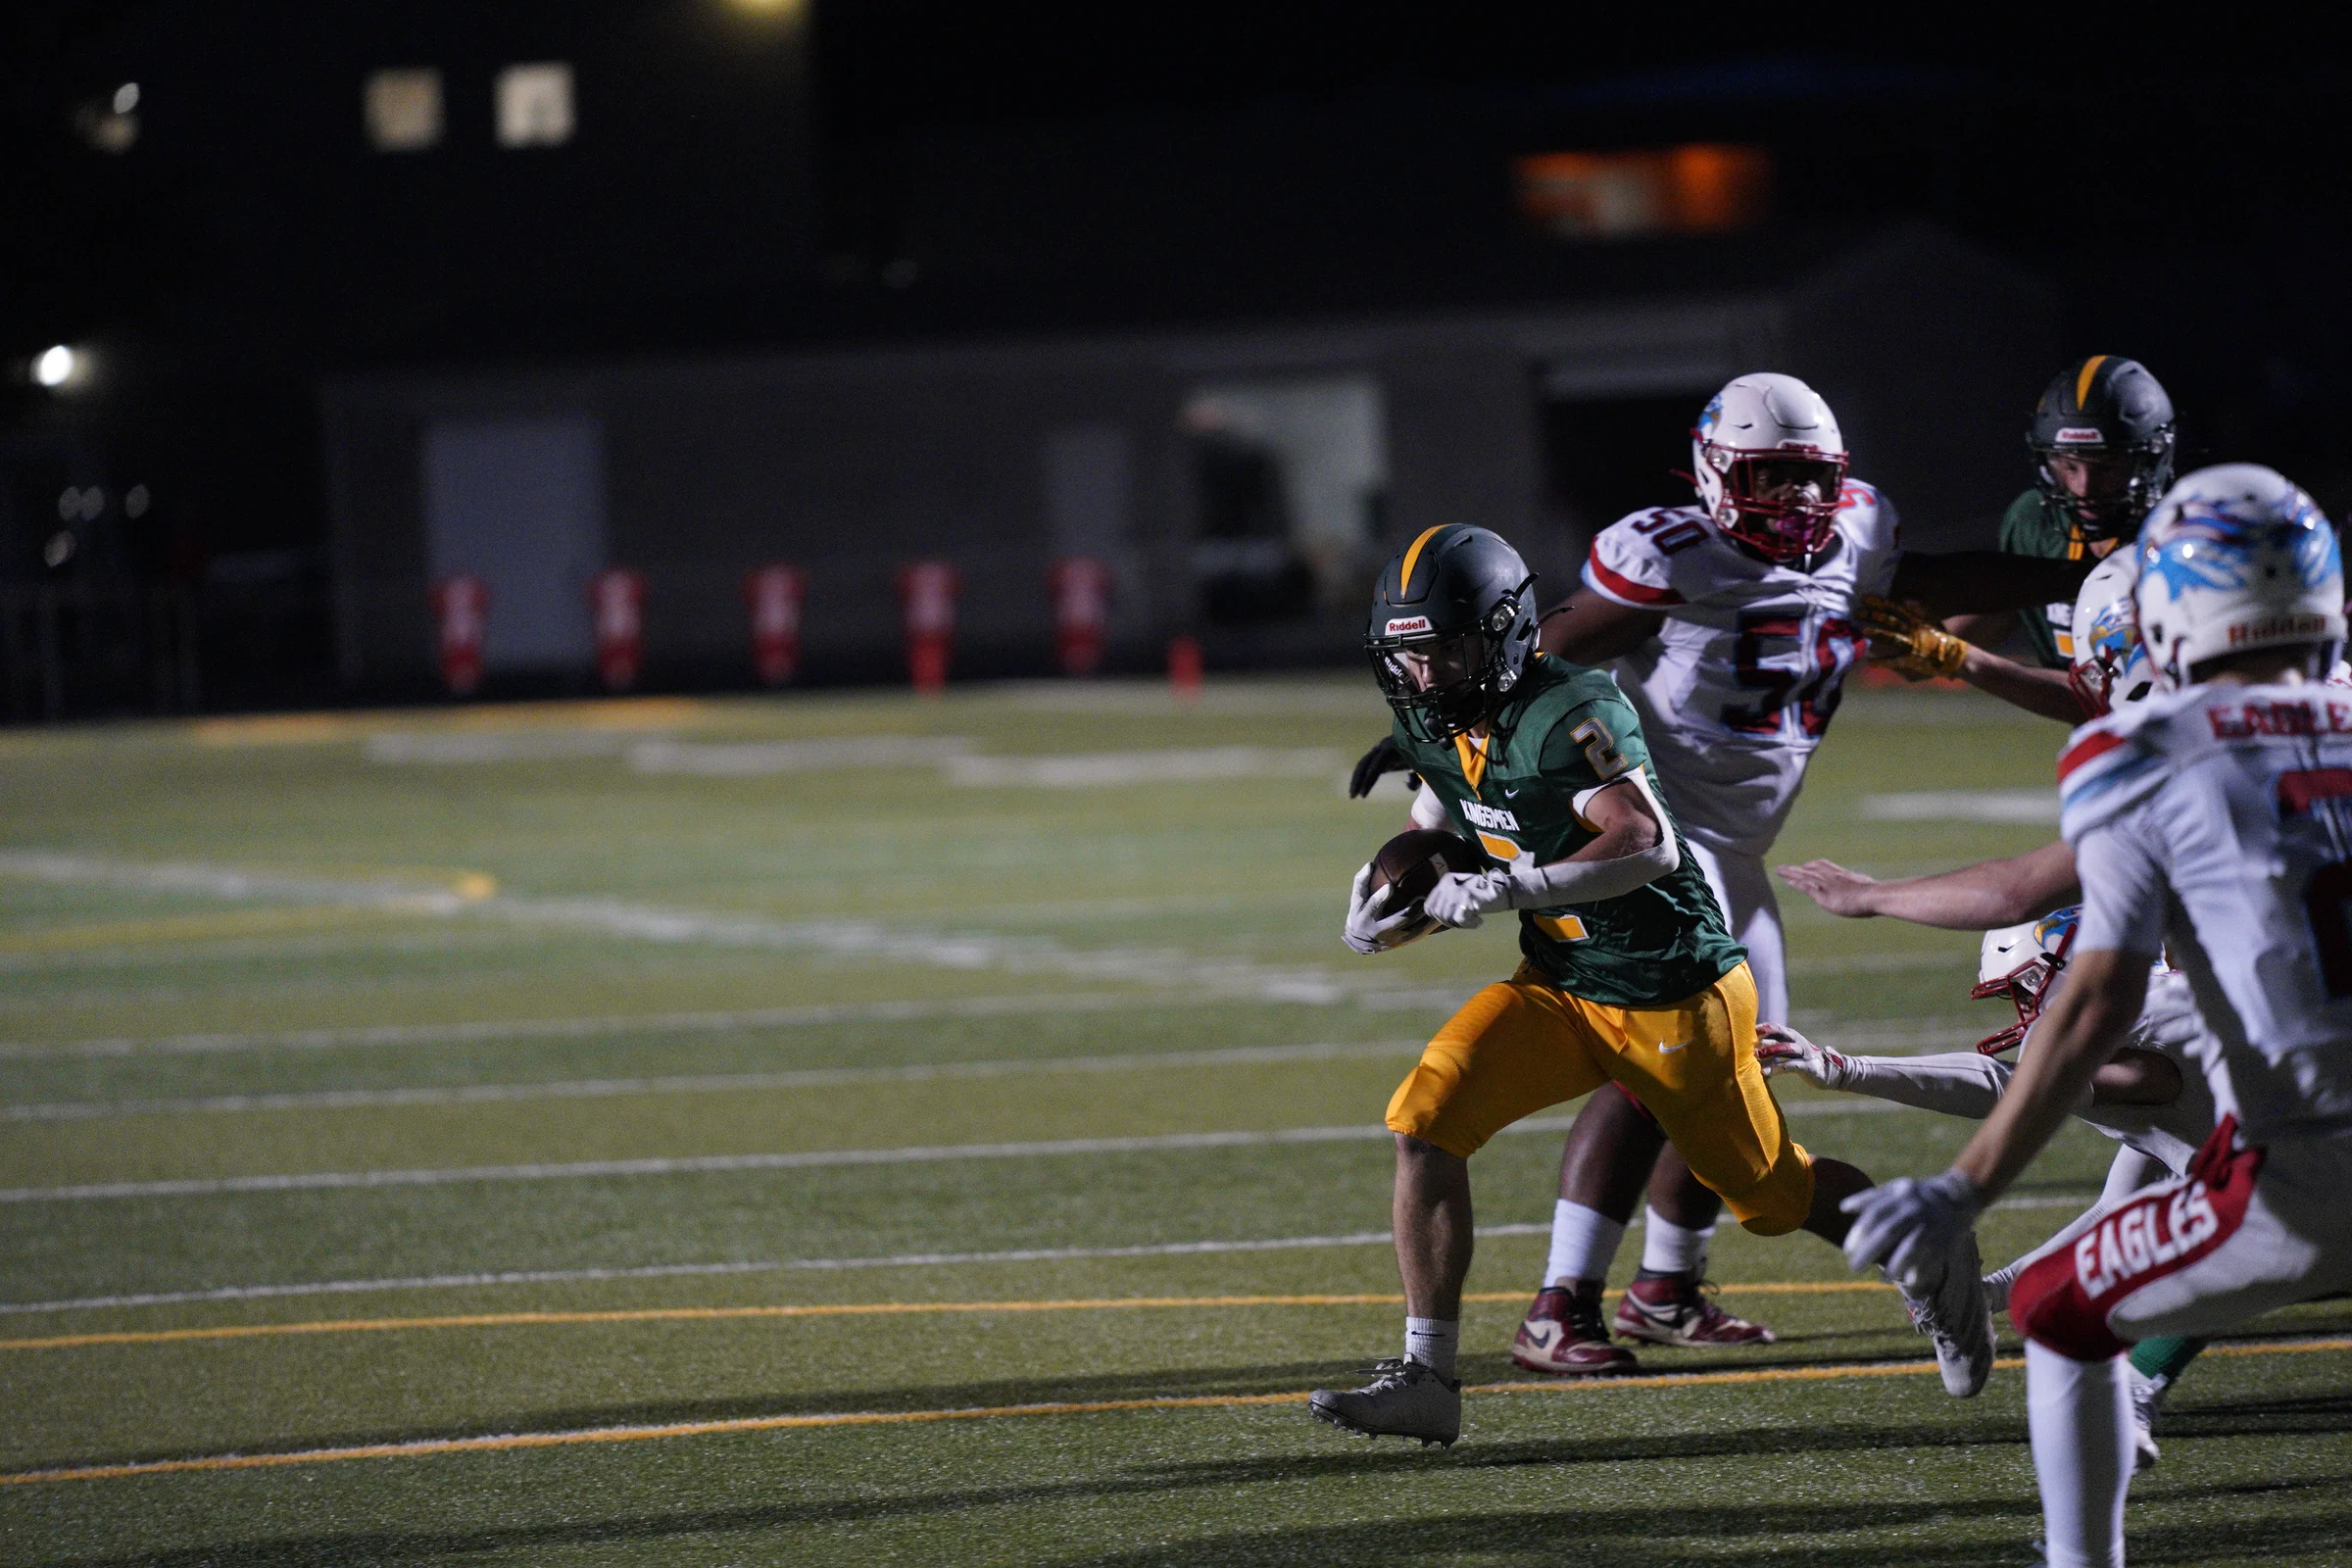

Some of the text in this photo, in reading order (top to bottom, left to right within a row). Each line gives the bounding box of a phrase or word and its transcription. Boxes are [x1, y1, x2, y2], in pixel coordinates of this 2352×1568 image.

[1631, 508, 1709, 557] 50
[1389, 618, 1426, 632] Riddell
[1570, 716, 1629, 780] 2
[1459, 799, 1521, 832] KINGSMEN
[2075, 1180, 2219, 1300] EAGLES
